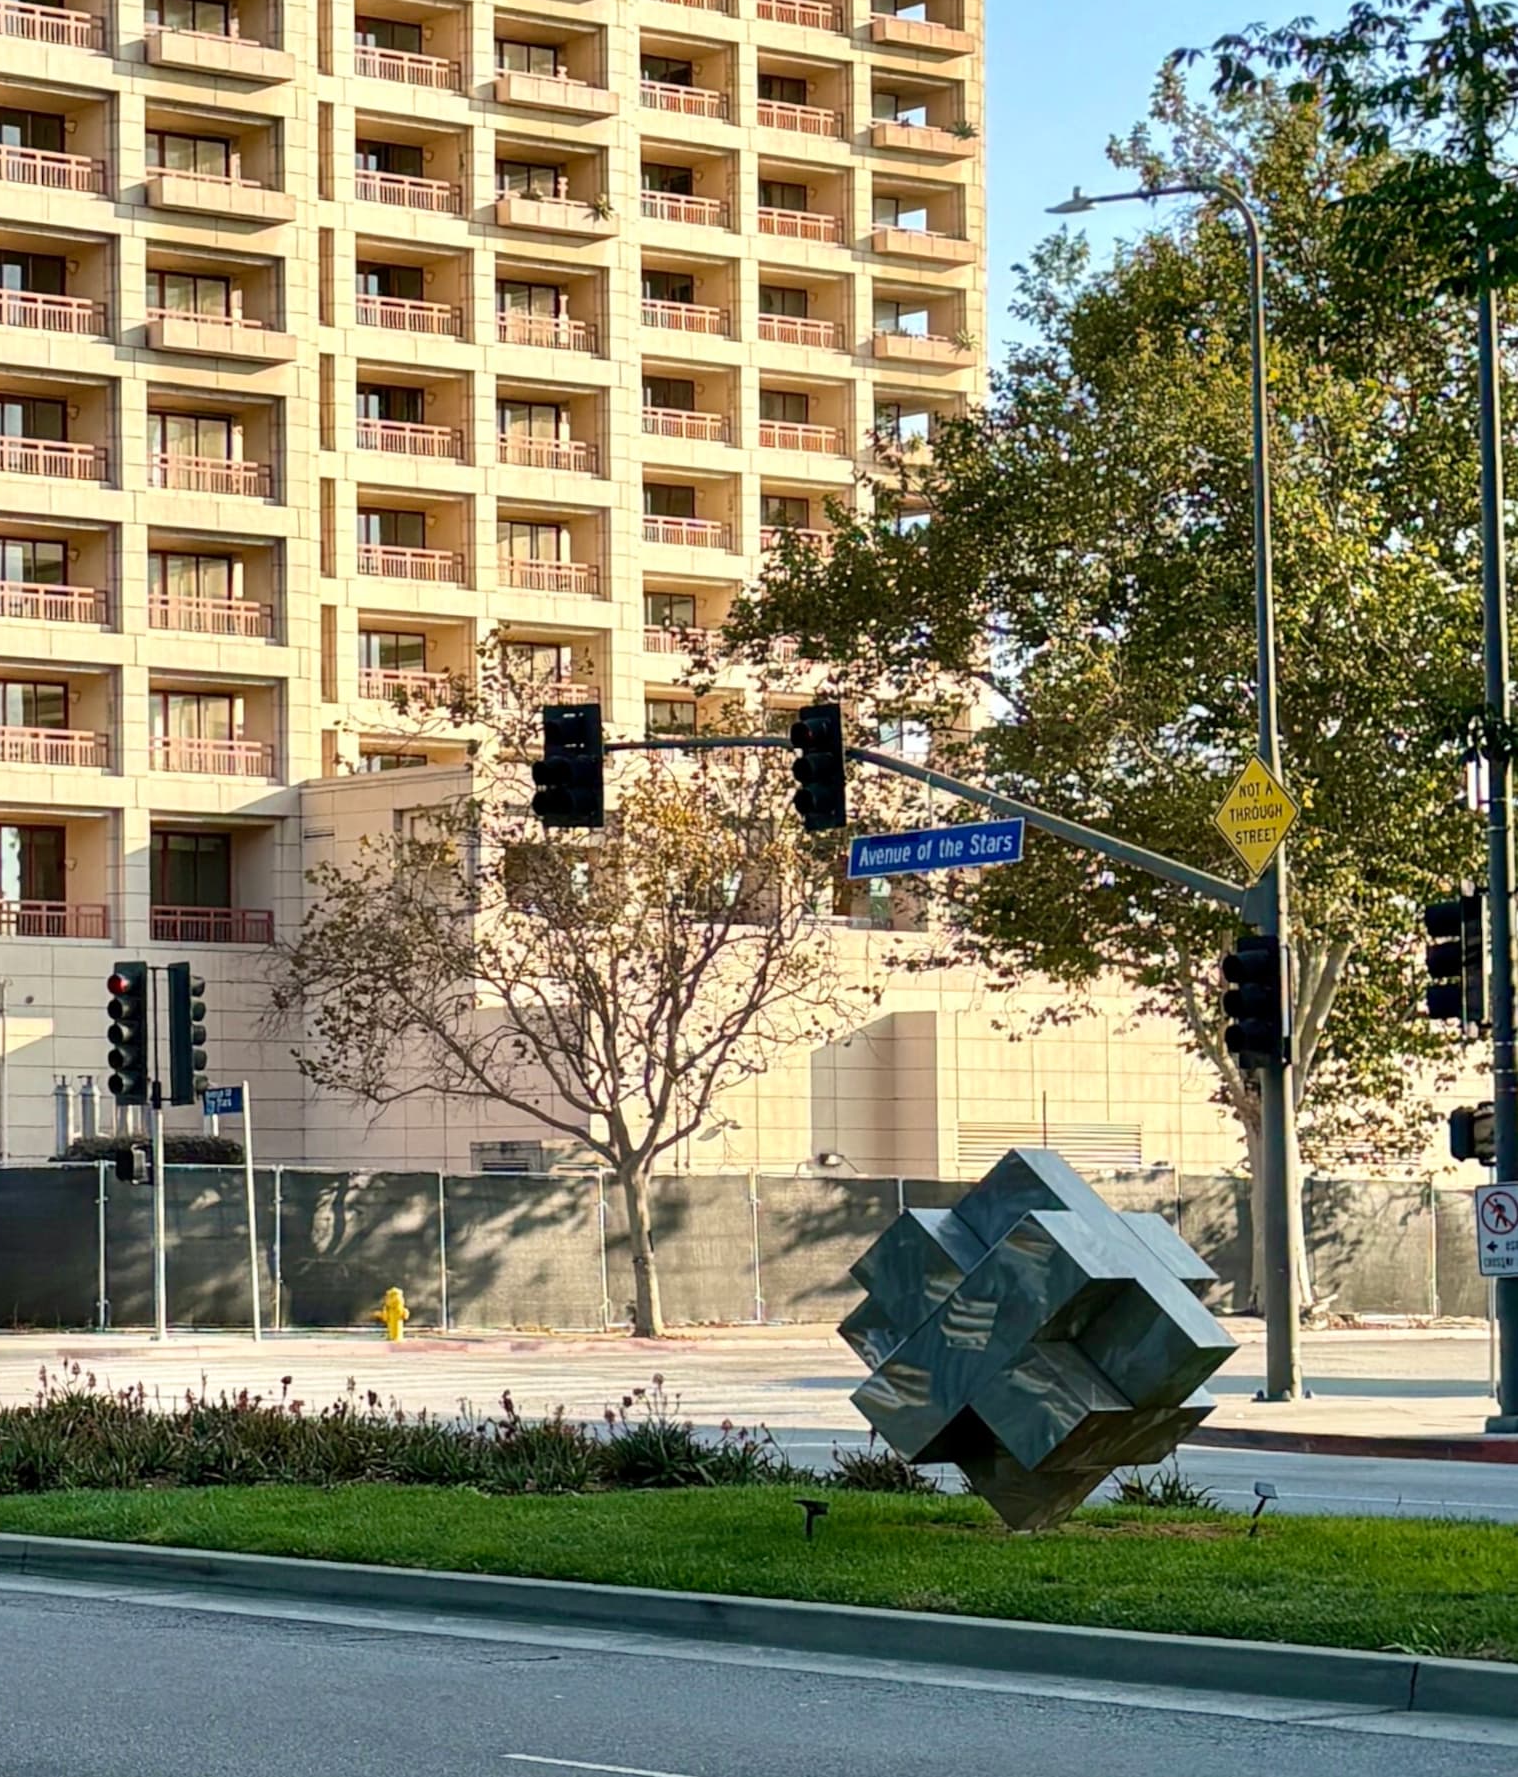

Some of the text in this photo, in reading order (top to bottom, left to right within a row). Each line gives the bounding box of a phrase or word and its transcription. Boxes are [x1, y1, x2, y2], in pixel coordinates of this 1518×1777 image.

[1238, 781, 1273, 798] NOT A
[1229, 804, 1283, 823] THROUGH
[1235, 827, 1278, 845] STREET
[858, 832, 1013, 868] Avenue of the Stars
